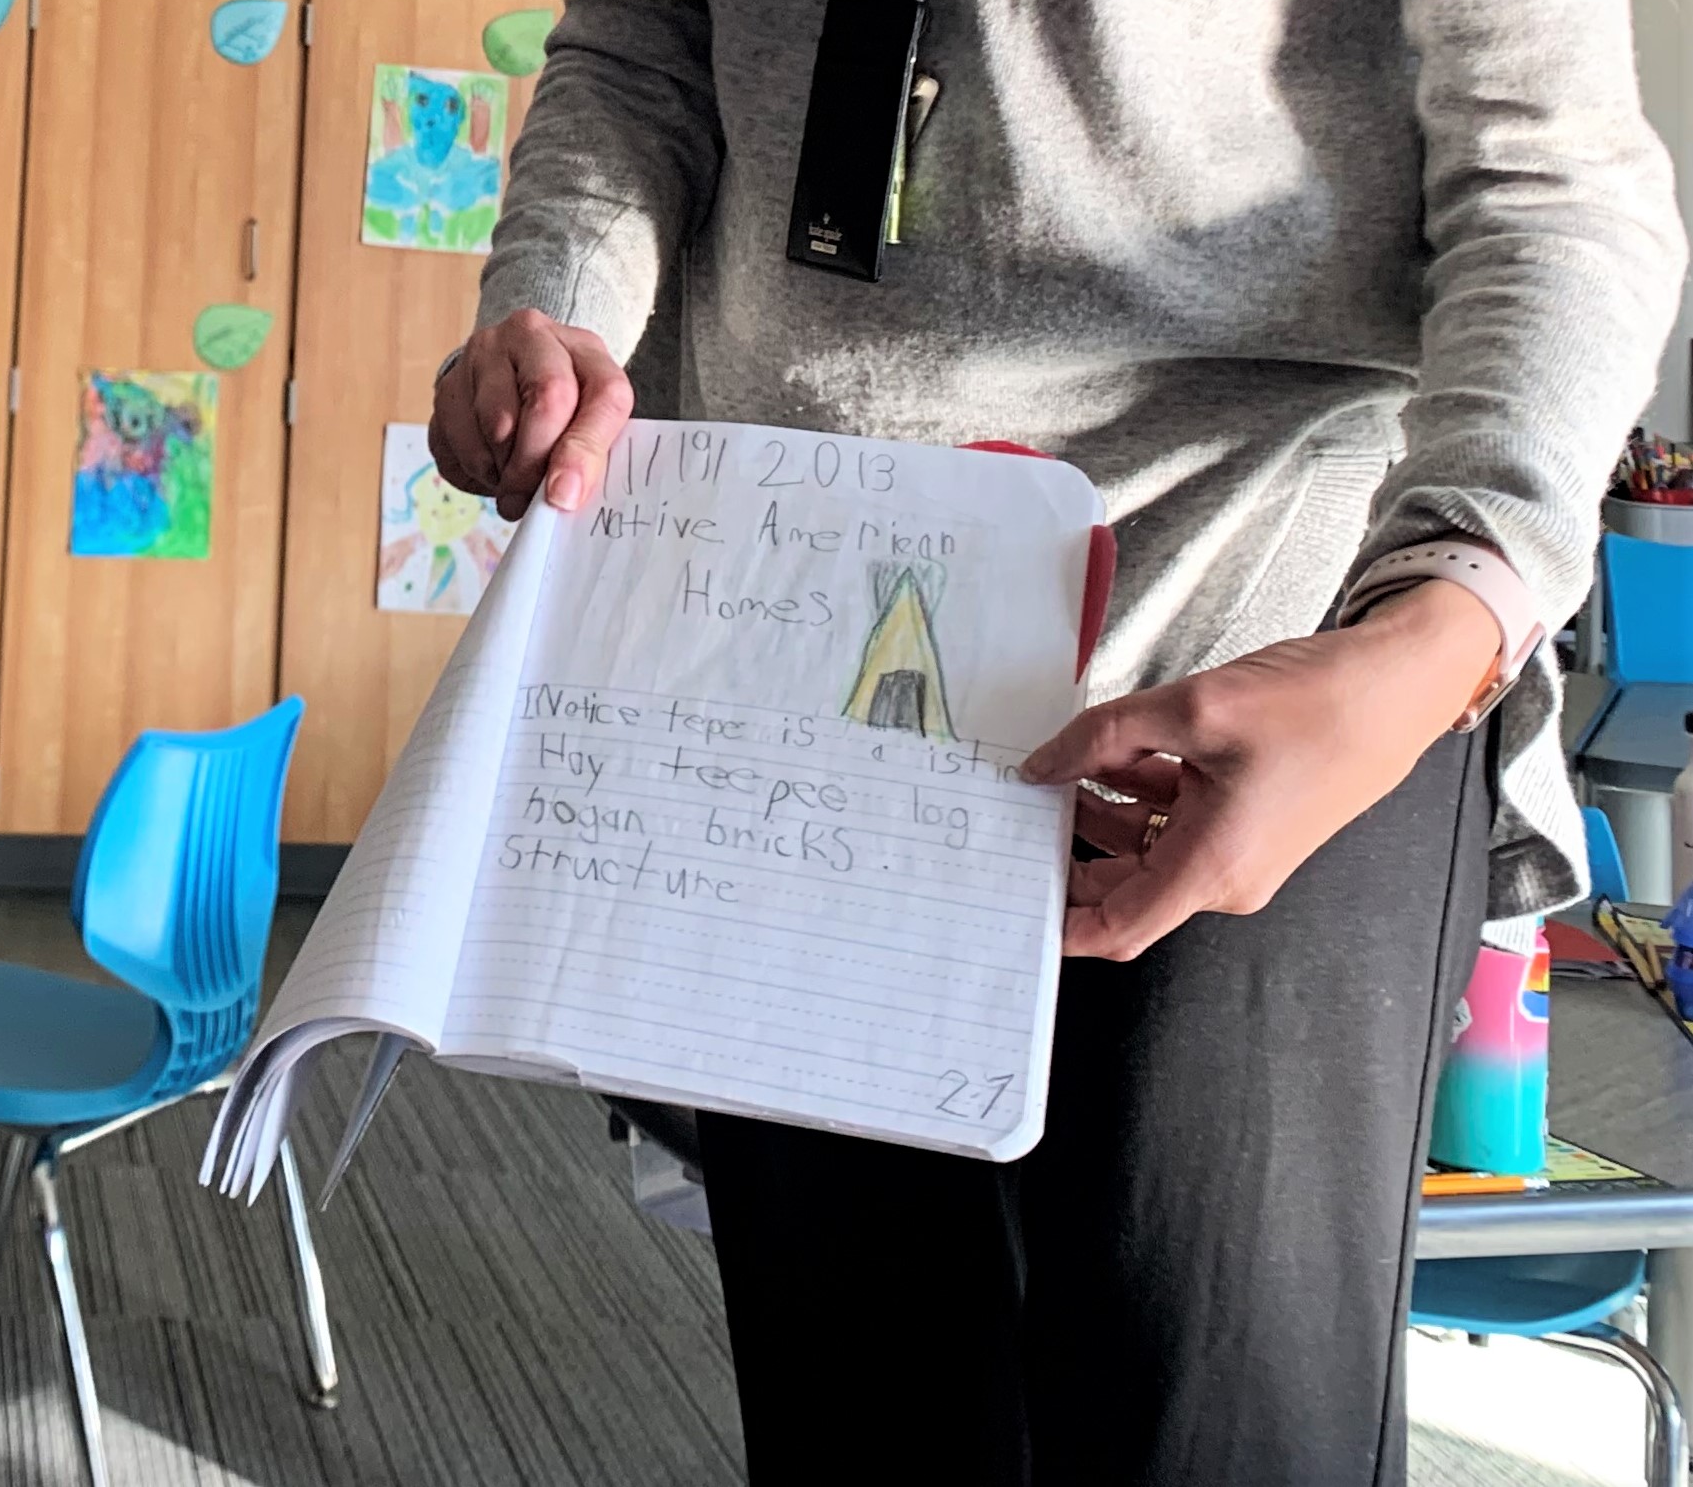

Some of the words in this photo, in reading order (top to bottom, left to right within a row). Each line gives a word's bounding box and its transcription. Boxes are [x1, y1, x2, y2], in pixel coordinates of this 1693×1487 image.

[683, 560, 833, 626] Homes
[782, 716, 816, 747] is
[913, 785, 970, 851] log
